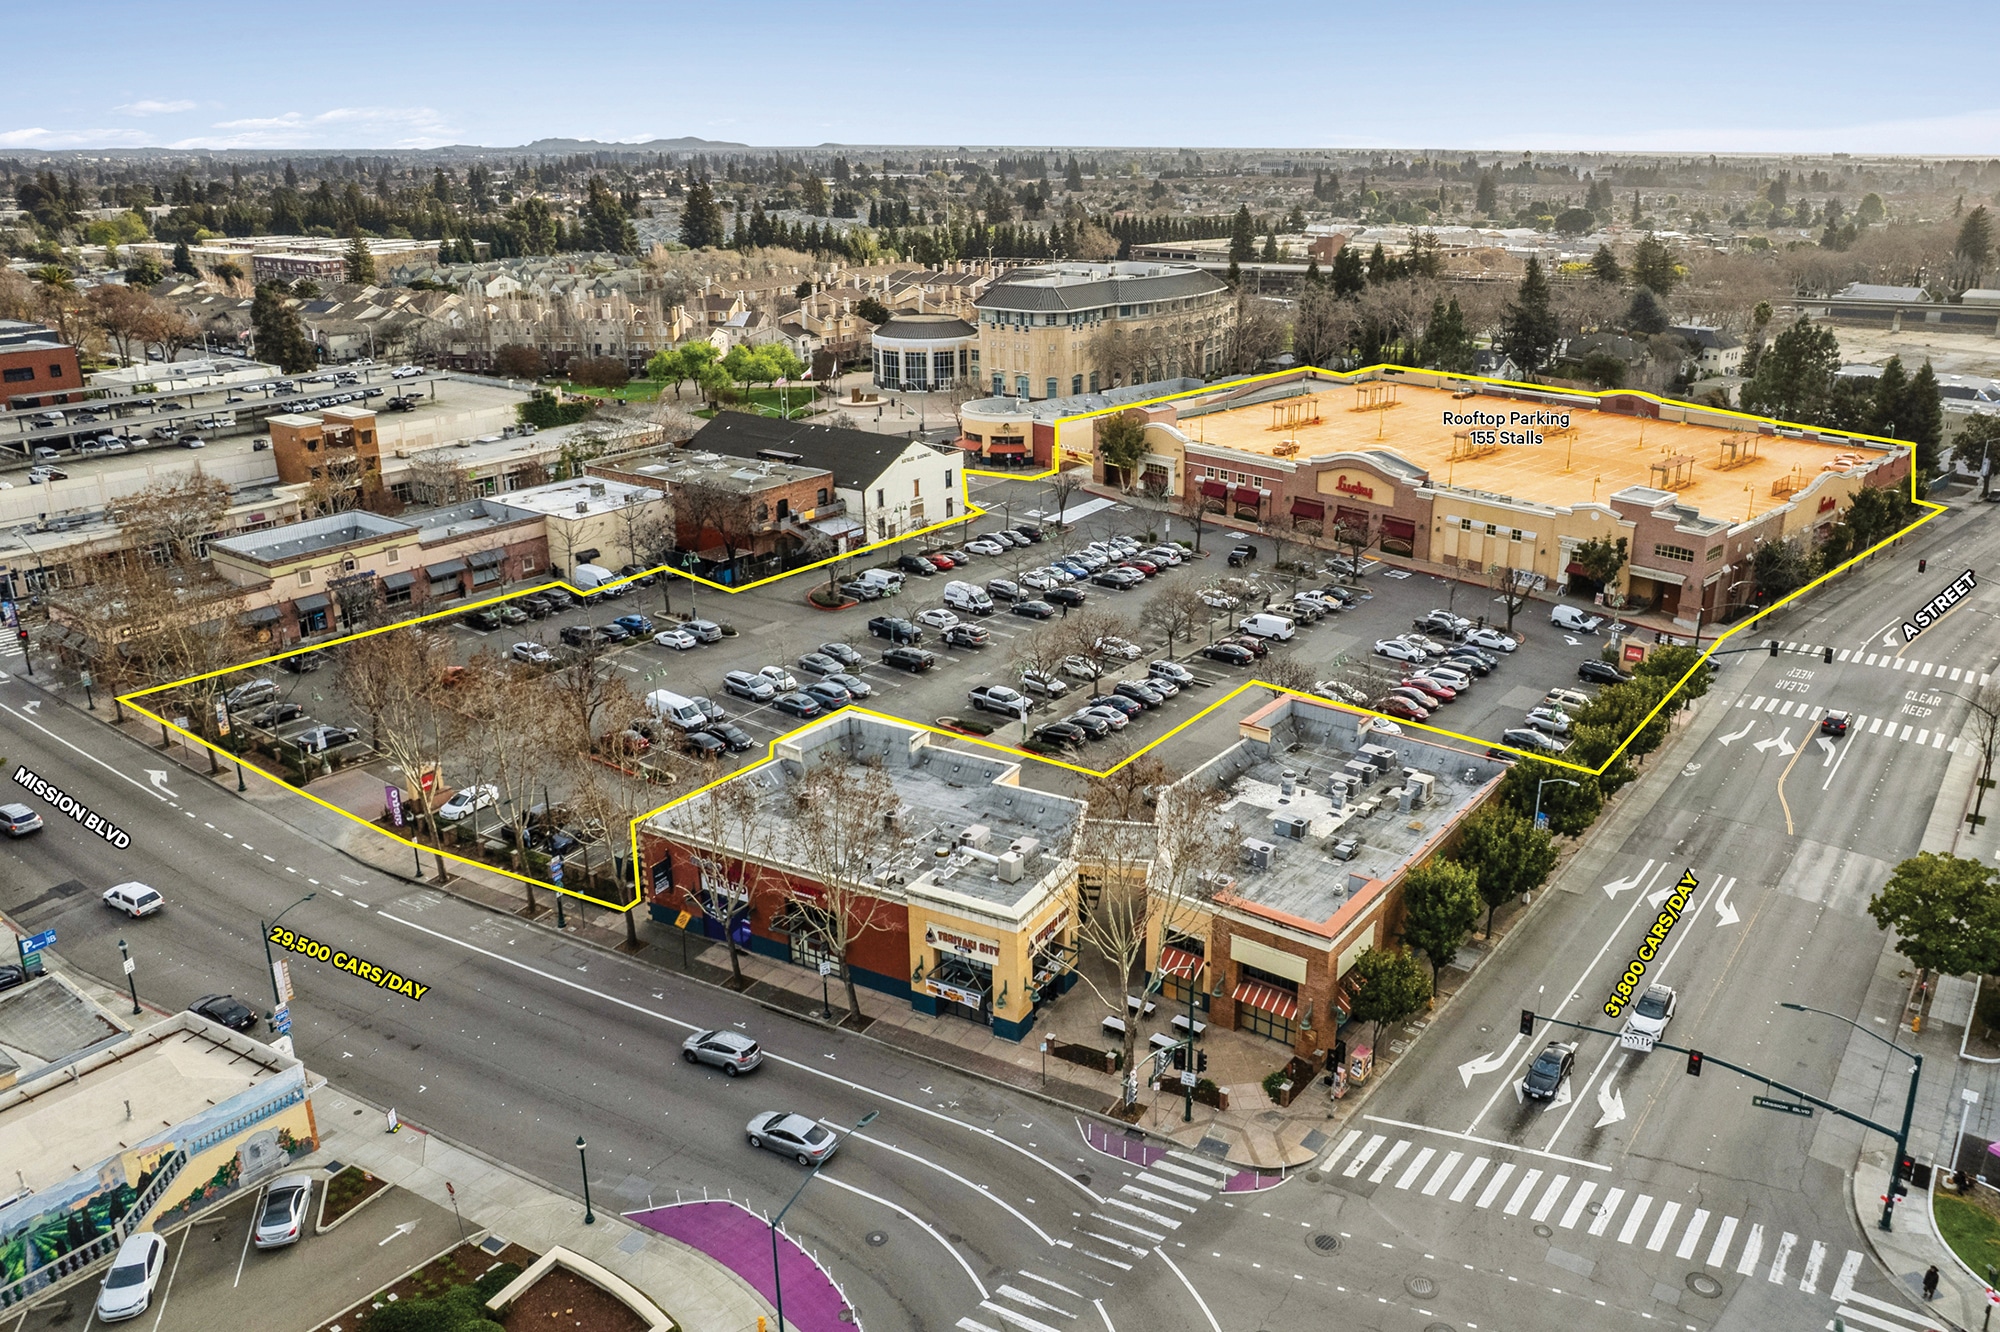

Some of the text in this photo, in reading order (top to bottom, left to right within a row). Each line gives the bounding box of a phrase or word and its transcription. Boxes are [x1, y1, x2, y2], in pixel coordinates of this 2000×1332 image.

[1335, 475, 1373, 499] Lucky
[1775, 679, 1810, 693] CLEAR
[1905, 690, 1942, 707] CLEAR
[1901, 703, 1933, 718] KEEP
[22, 940, 33, 953] P
[937, 931, 1000, 956] TERIYAKI CITY
